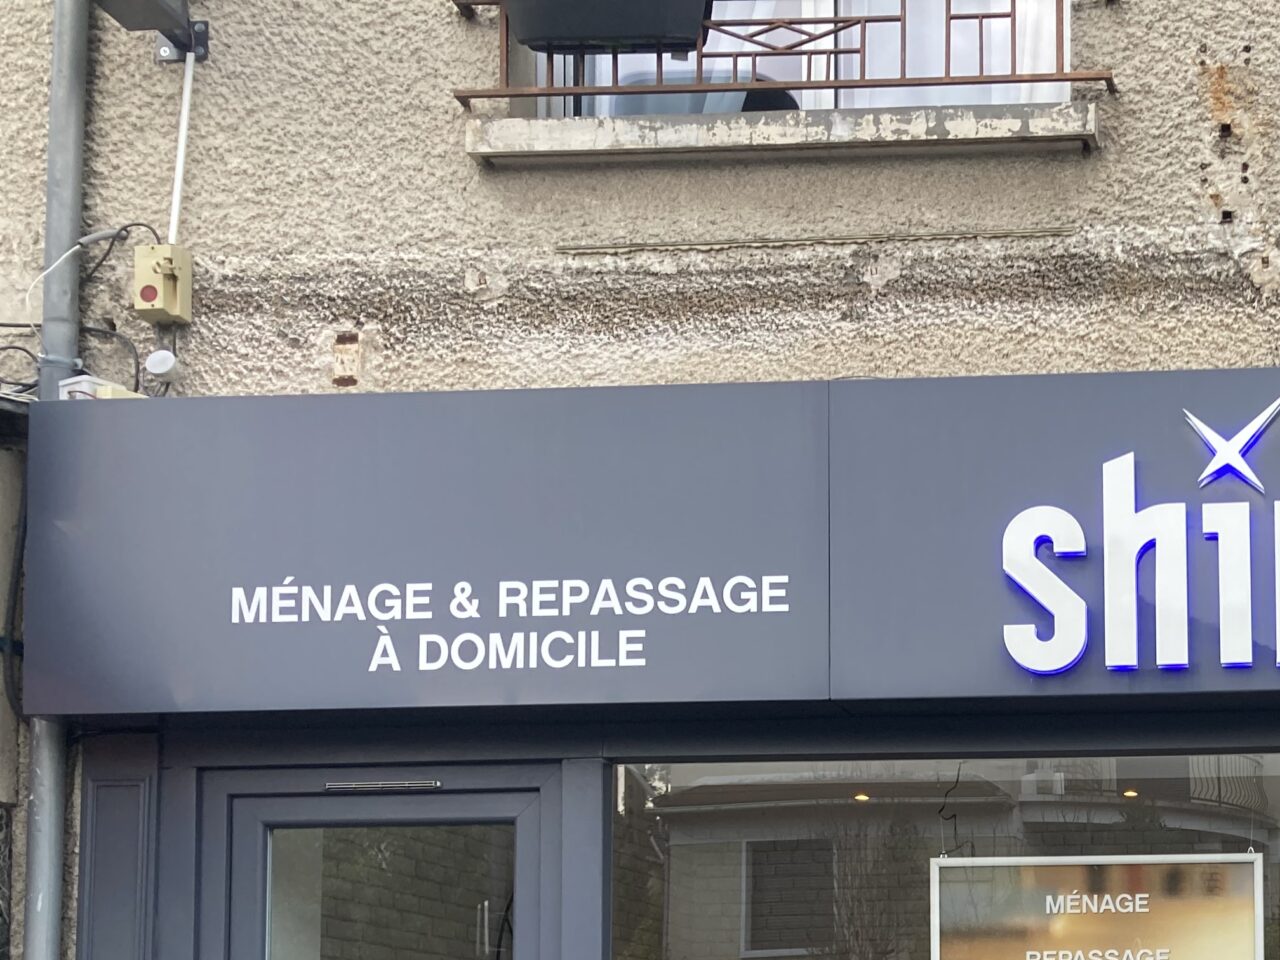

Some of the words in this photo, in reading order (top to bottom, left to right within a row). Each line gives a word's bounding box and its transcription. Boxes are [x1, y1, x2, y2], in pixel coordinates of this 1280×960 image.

[230, 576, 433, 624] MÉNAGE
[448, 580, 481, 619] &
[497, 574, 790, 618] REPASSAGE
[368, 625, 402, 672] À
[417, 629, 647, 671] DOMICILE
[1045, 890, 1150, 914] MÉNAGE
